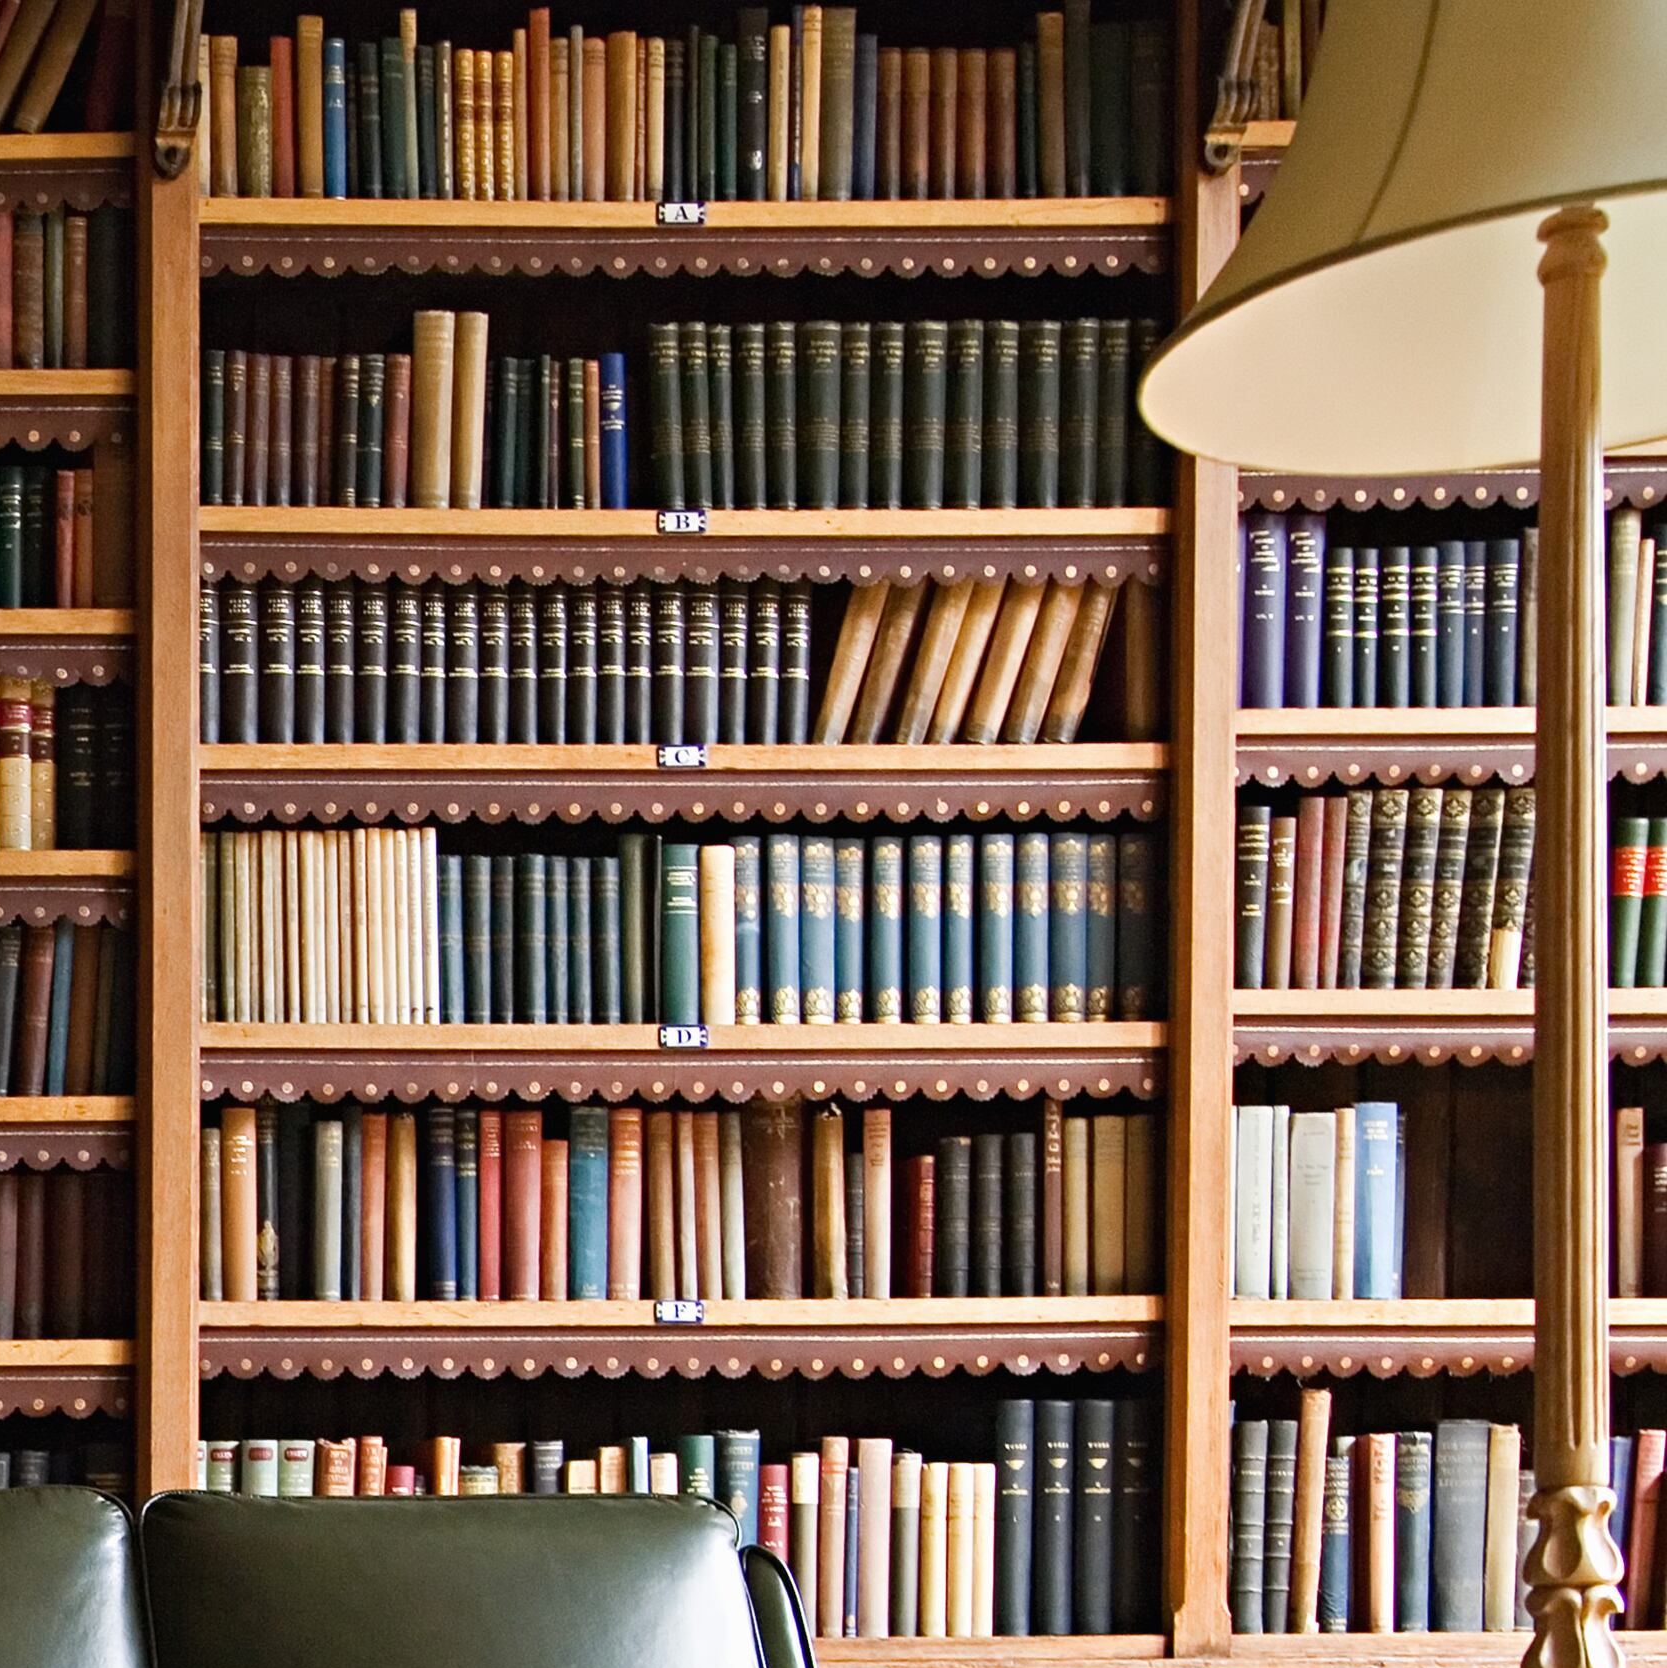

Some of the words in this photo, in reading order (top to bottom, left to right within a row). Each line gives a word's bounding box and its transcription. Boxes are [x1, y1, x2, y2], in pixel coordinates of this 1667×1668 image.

[675, 206, 689, 220] A
[676, 515, 689, 529] B
[675, 751, 689, 764] C
[678, 1030, 691, 1043] D
[675, 1305, 687, 1319] F
